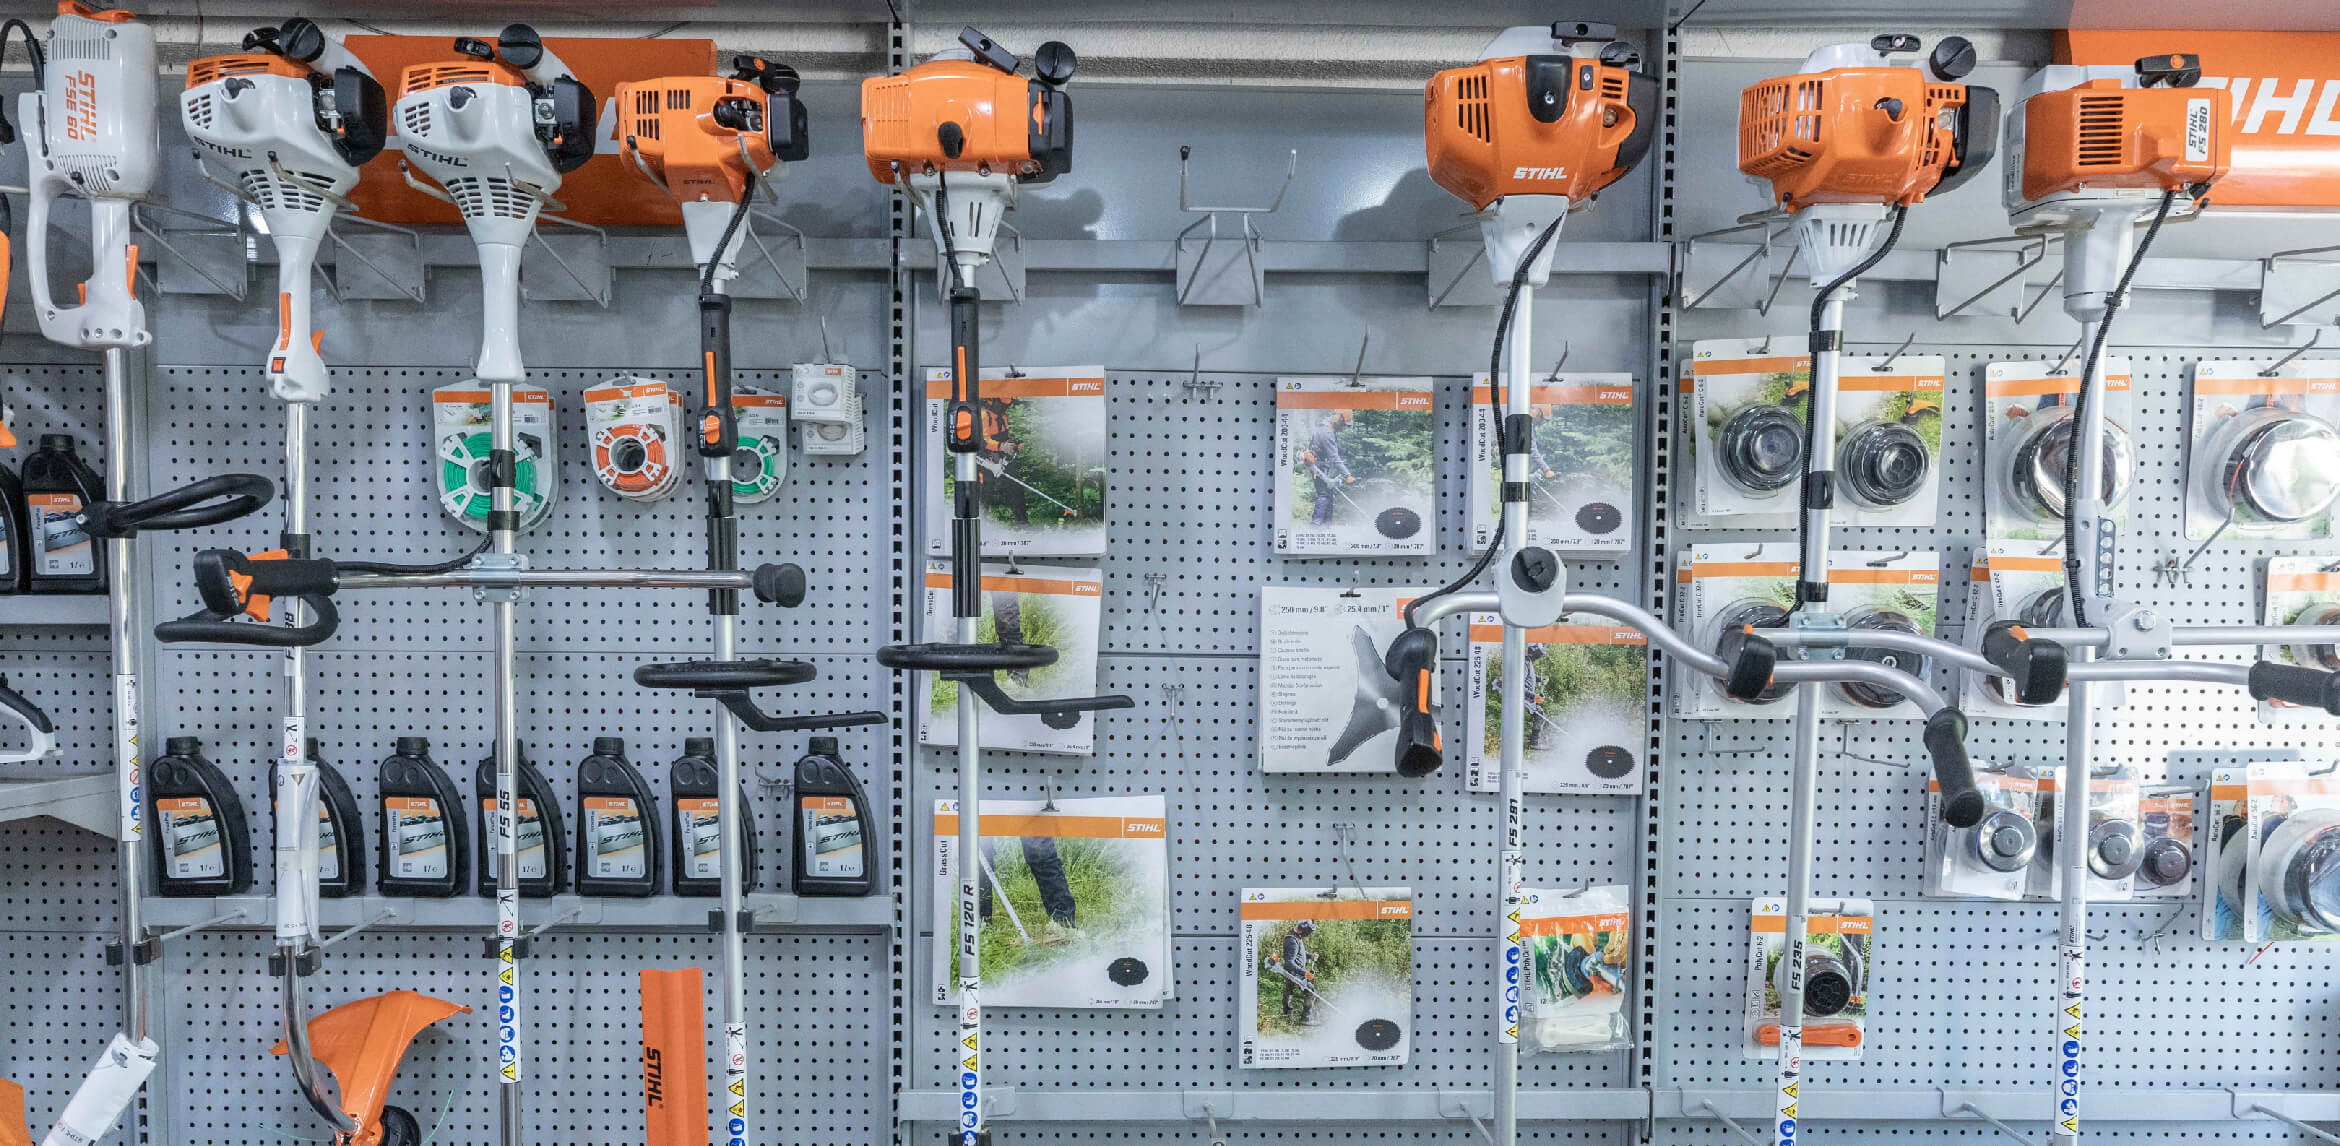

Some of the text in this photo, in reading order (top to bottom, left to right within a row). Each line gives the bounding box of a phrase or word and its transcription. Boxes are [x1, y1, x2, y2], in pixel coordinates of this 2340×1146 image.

[65, 75, 79, 140] FSE 60
[78, 69, 97, 142] STIHL
[2189, 111, 2198, 148] STIHL
[2198, 106, 2208, 154] FS 280
[193, 136, 253, 159] STIHL
[407, 143, 468, 168] STIHL
[1513, 166, 1568, 180] STIHL
[1071, 383, 1101, 391] STIHL
[2107, 379, 2128, 387] TIHL
[1400, 398, 1430, 406] STIHL
[1599, 392, 1629, 400] STIHL
[1615, 632, 1643, 640] STIHL
[499, 789, 511, 838] FS 55
[1509, 798, 1519, 848] FS 281
[1127, 823, 1161, 832] STIHL
[964, 884, 976, 956] FS 120 R
[1840, 921, 1869, 930] STIHL
[1754, 946, 1762, 971] PolyCut
[1791, 939, 1803, 991] FS 235
[646, 1046, 663, 1108] STIHL
